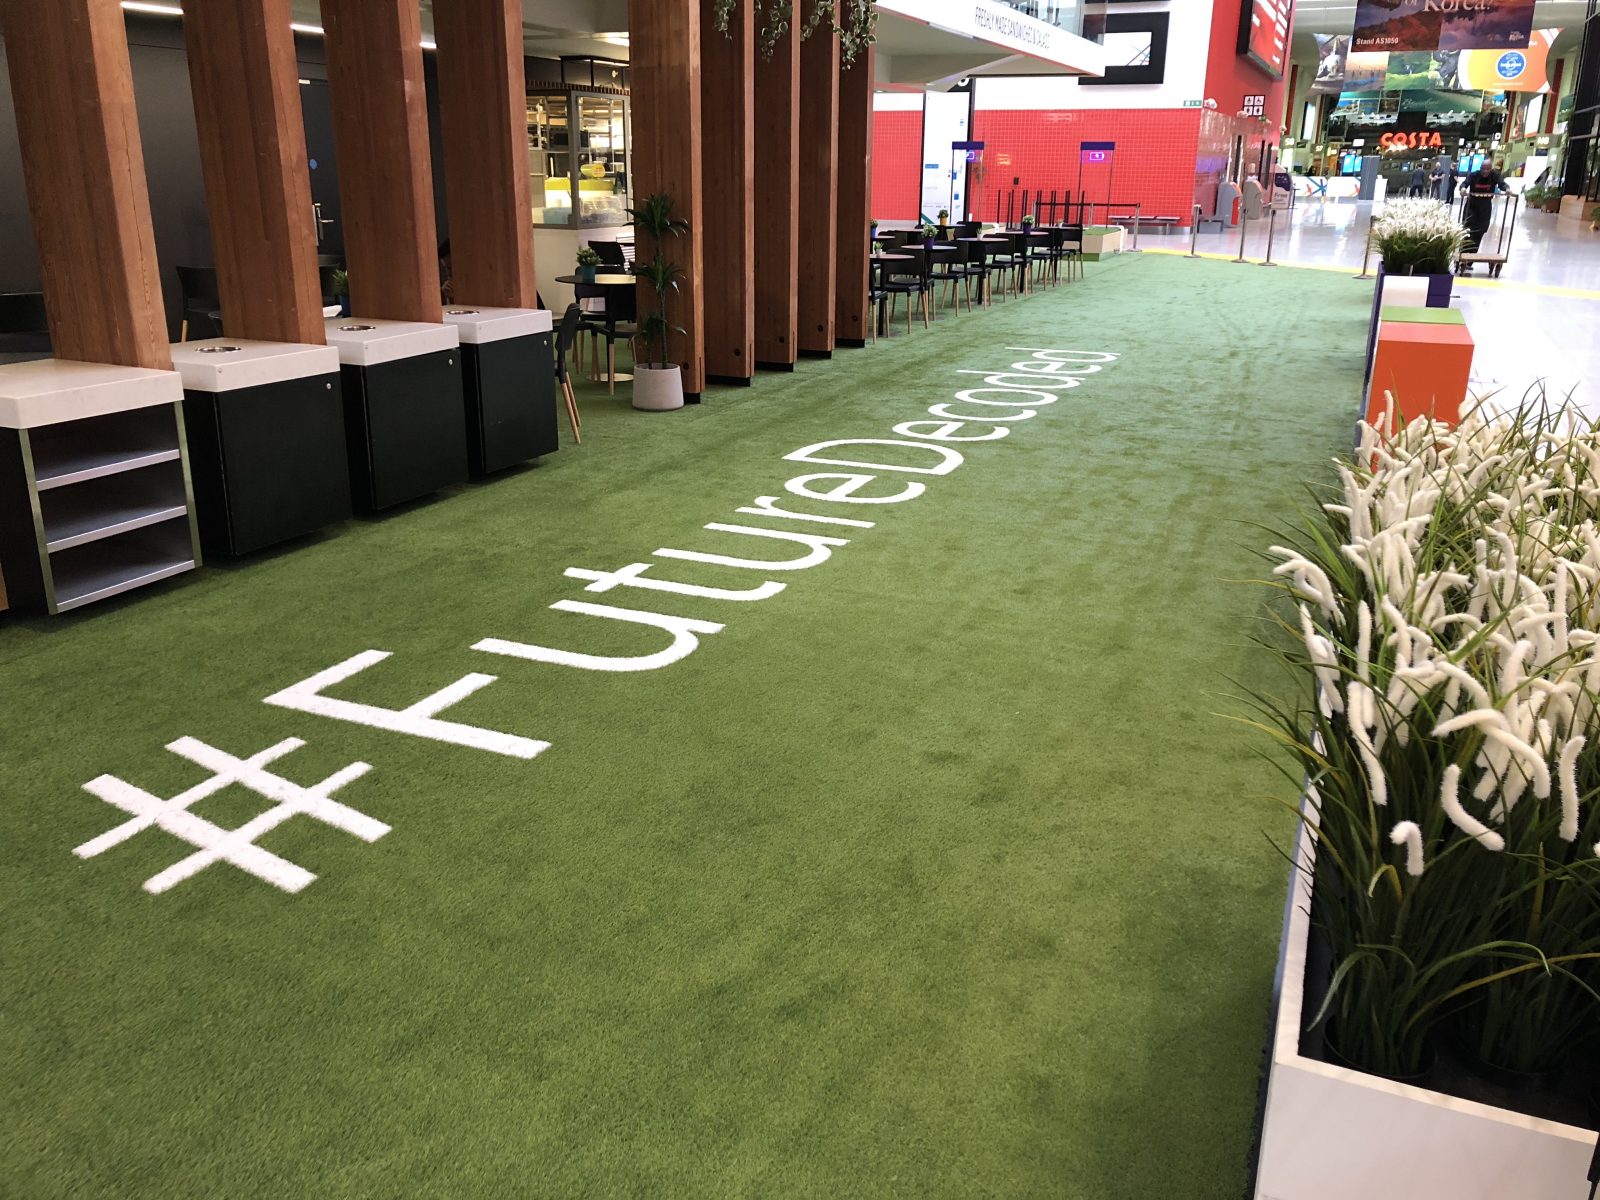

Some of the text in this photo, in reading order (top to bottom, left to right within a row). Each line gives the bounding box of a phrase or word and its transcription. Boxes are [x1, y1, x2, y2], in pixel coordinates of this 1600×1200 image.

[975, 6, 994, 30] FRESHLY
[1375, 37, 1399, 45] AS1050
[1380, 132, 1442, 148] COSTA
[72, 346, 1120, 894] #FutureDecoded
